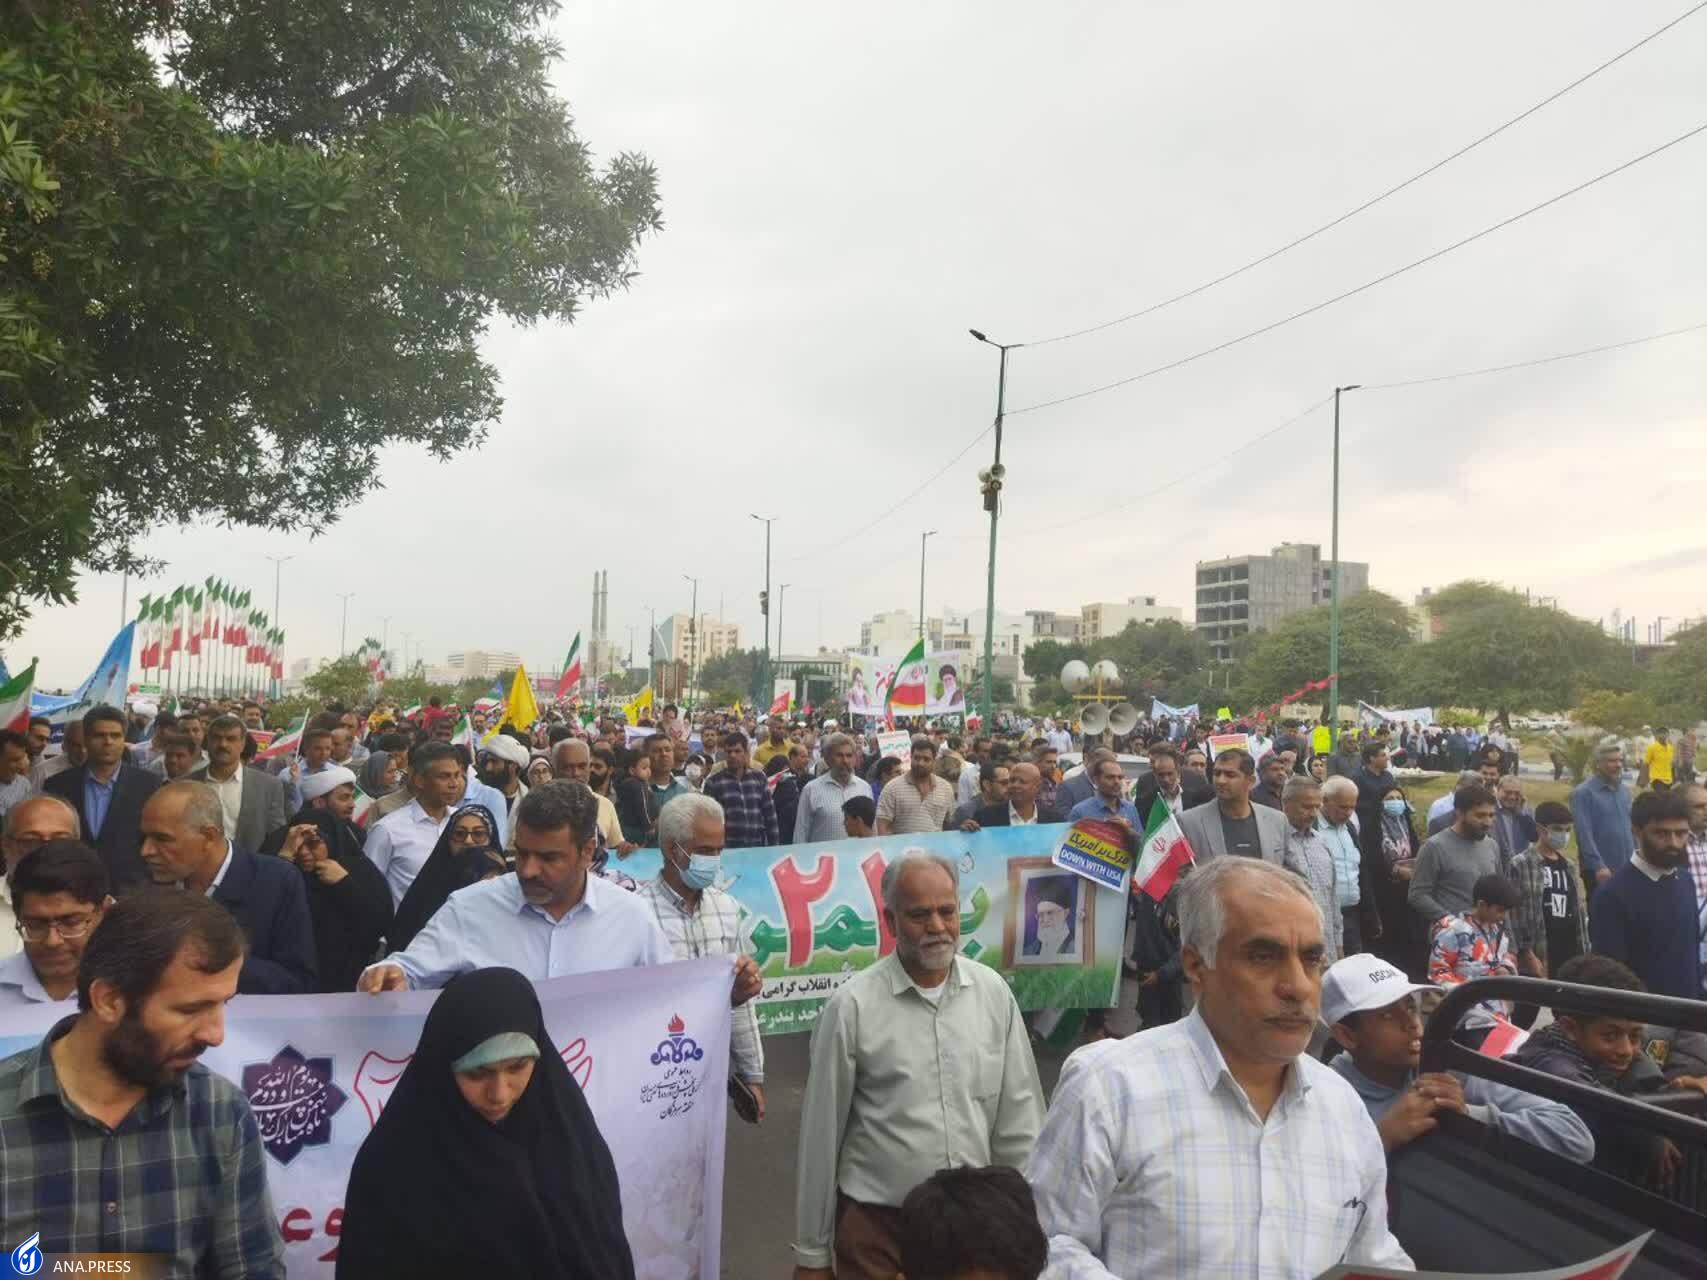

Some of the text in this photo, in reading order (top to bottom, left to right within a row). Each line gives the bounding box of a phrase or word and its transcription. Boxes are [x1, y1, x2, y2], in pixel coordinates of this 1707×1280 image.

[1061, 849, 1121, 881] DOWN WITH USA
[798, 977, 831, 996] انقلاب
